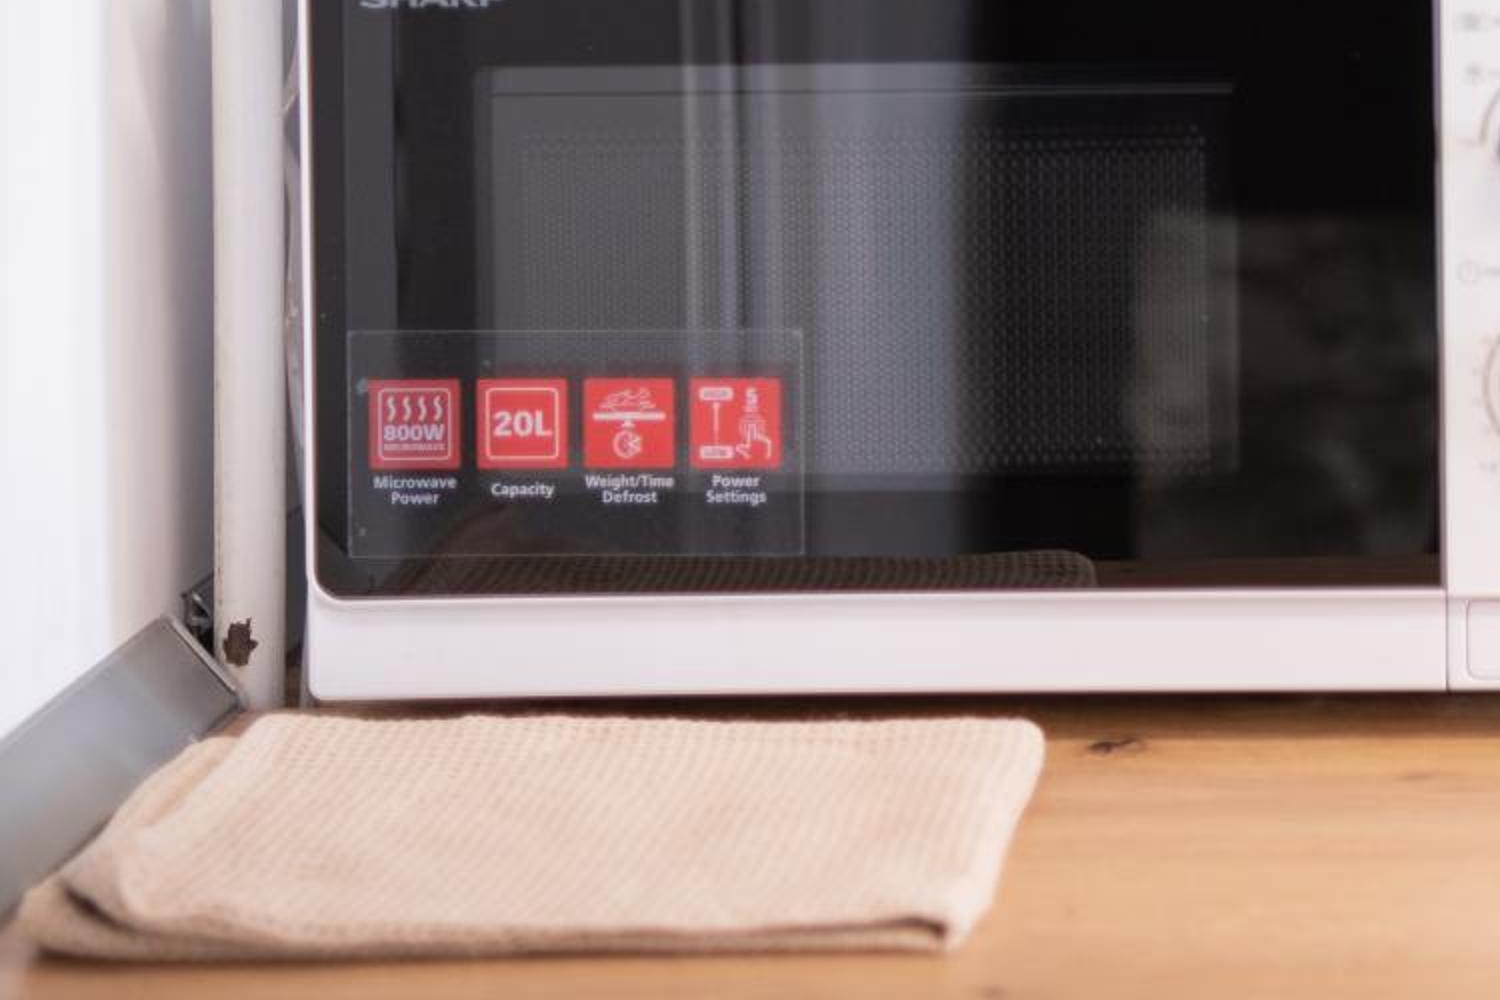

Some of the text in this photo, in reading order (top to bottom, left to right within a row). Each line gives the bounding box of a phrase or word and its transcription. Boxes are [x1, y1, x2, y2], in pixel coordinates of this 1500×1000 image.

[493, 411, 552, 437] 20L
[383, 424, 445, 441] 800W
[373, 475, 457, 489] Microwave
[585, 474, 675, 491] Weight/Time
[712, 475, 760, 487] Power
[391, 491, 440, 505] Power
[491, 482, 555, 499] Capacity
[602, 489, 658, 503] Defrost
[706, 490, 767, 506] Settings
